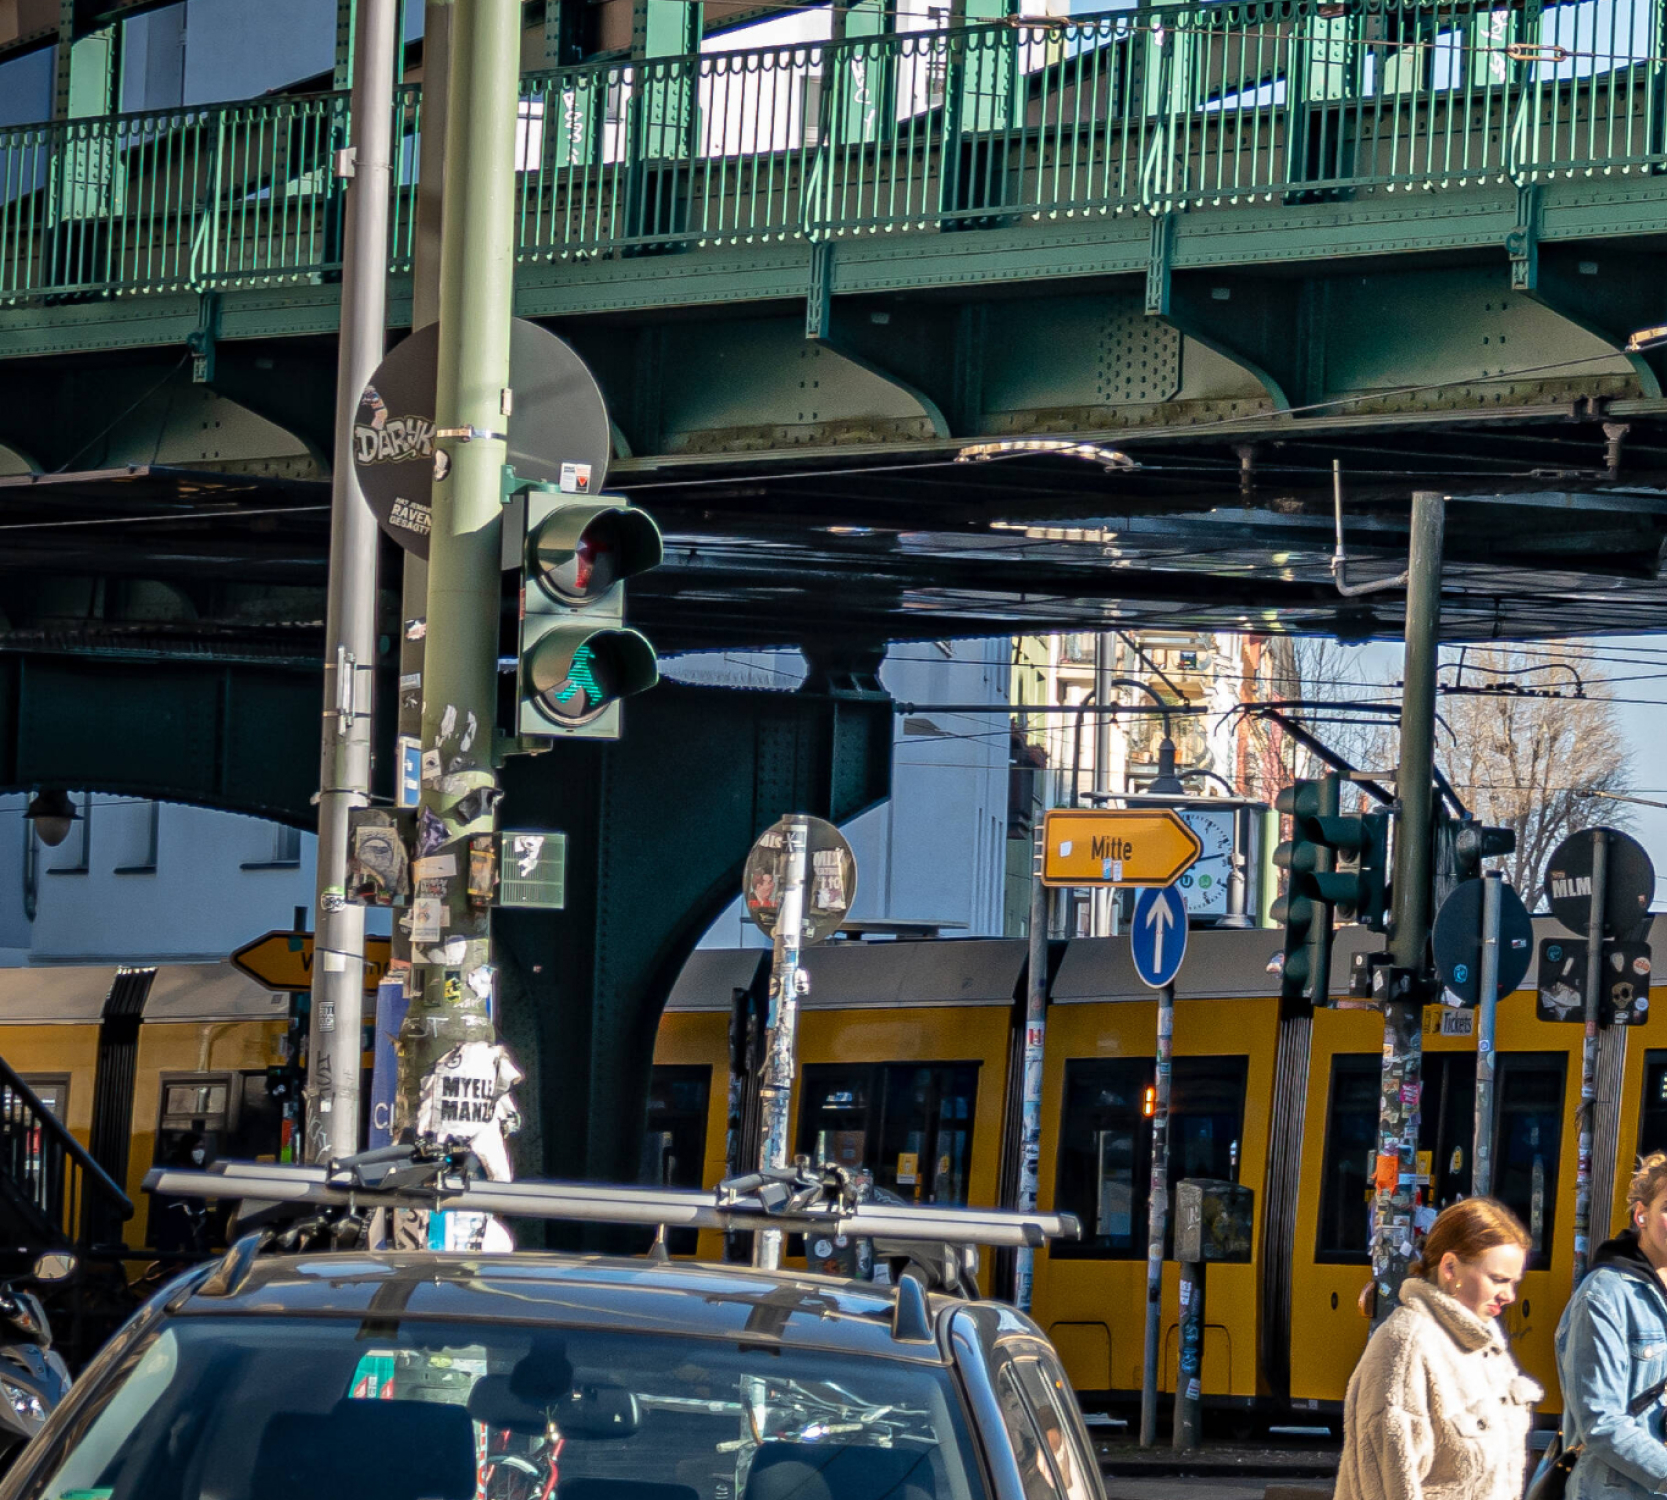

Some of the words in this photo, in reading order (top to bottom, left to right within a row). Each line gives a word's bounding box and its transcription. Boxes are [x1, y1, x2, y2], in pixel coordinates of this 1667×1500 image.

[1091, 835, 1133, 861] Mitte
[1552, 876, 1593, 899] MLM
[1444, 1010, 1472, 1034] Tickets
